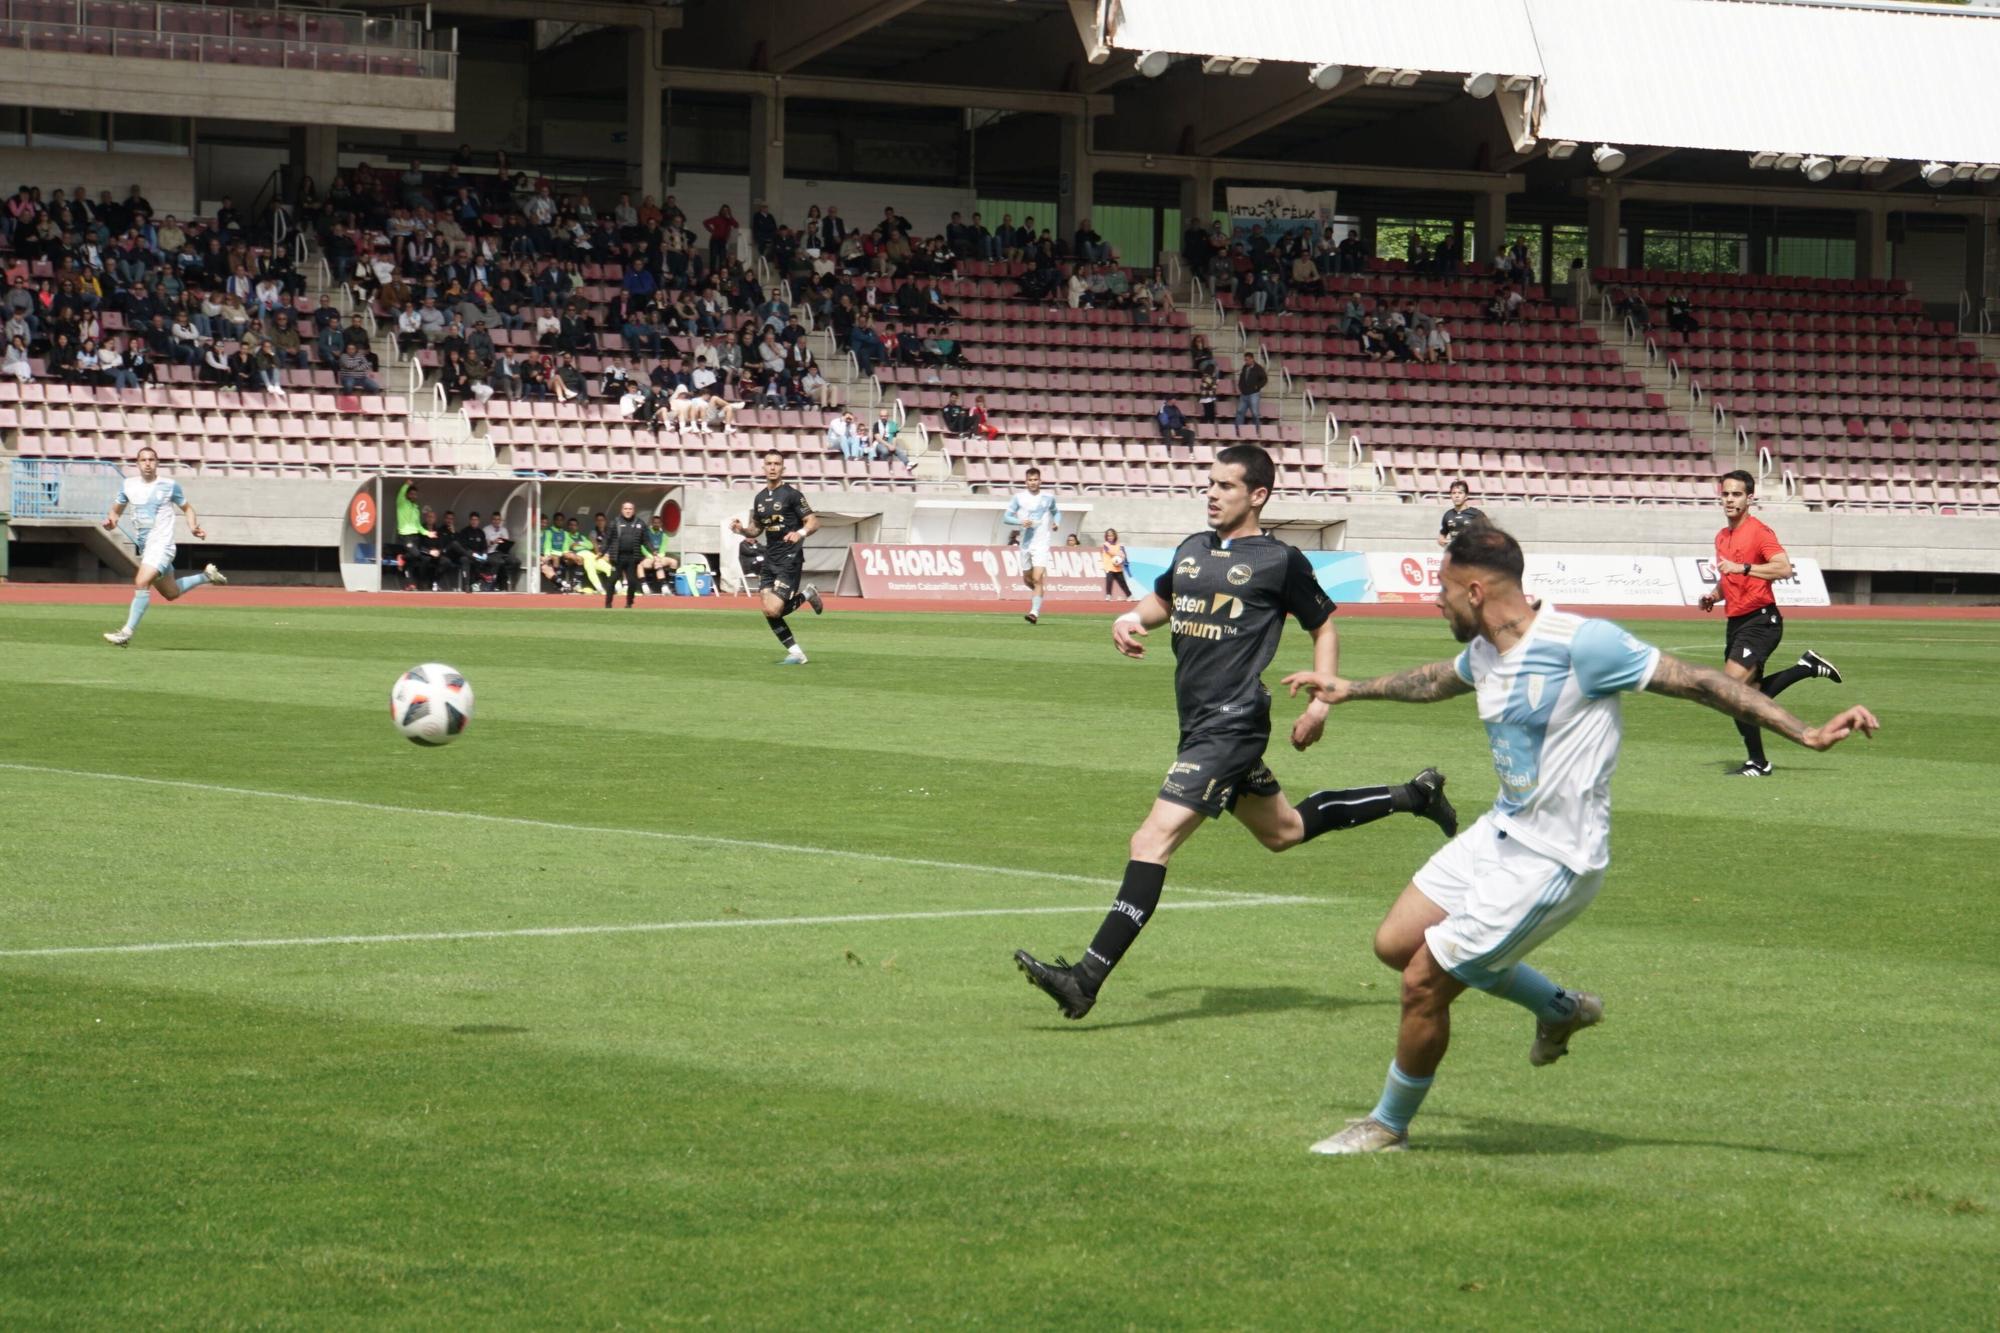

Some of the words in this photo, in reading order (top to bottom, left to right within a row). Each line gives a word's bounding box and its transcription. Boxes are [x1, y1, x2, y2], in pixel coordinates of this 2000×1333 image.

[861, 549, 889, 576] 24
[889, 549, 965, 577] HORAS
[887, 582, 917, 591] Ramón
[918, 582, 958, 591] Cabanillas
[1057, 583, 1103, 594] Compostela
